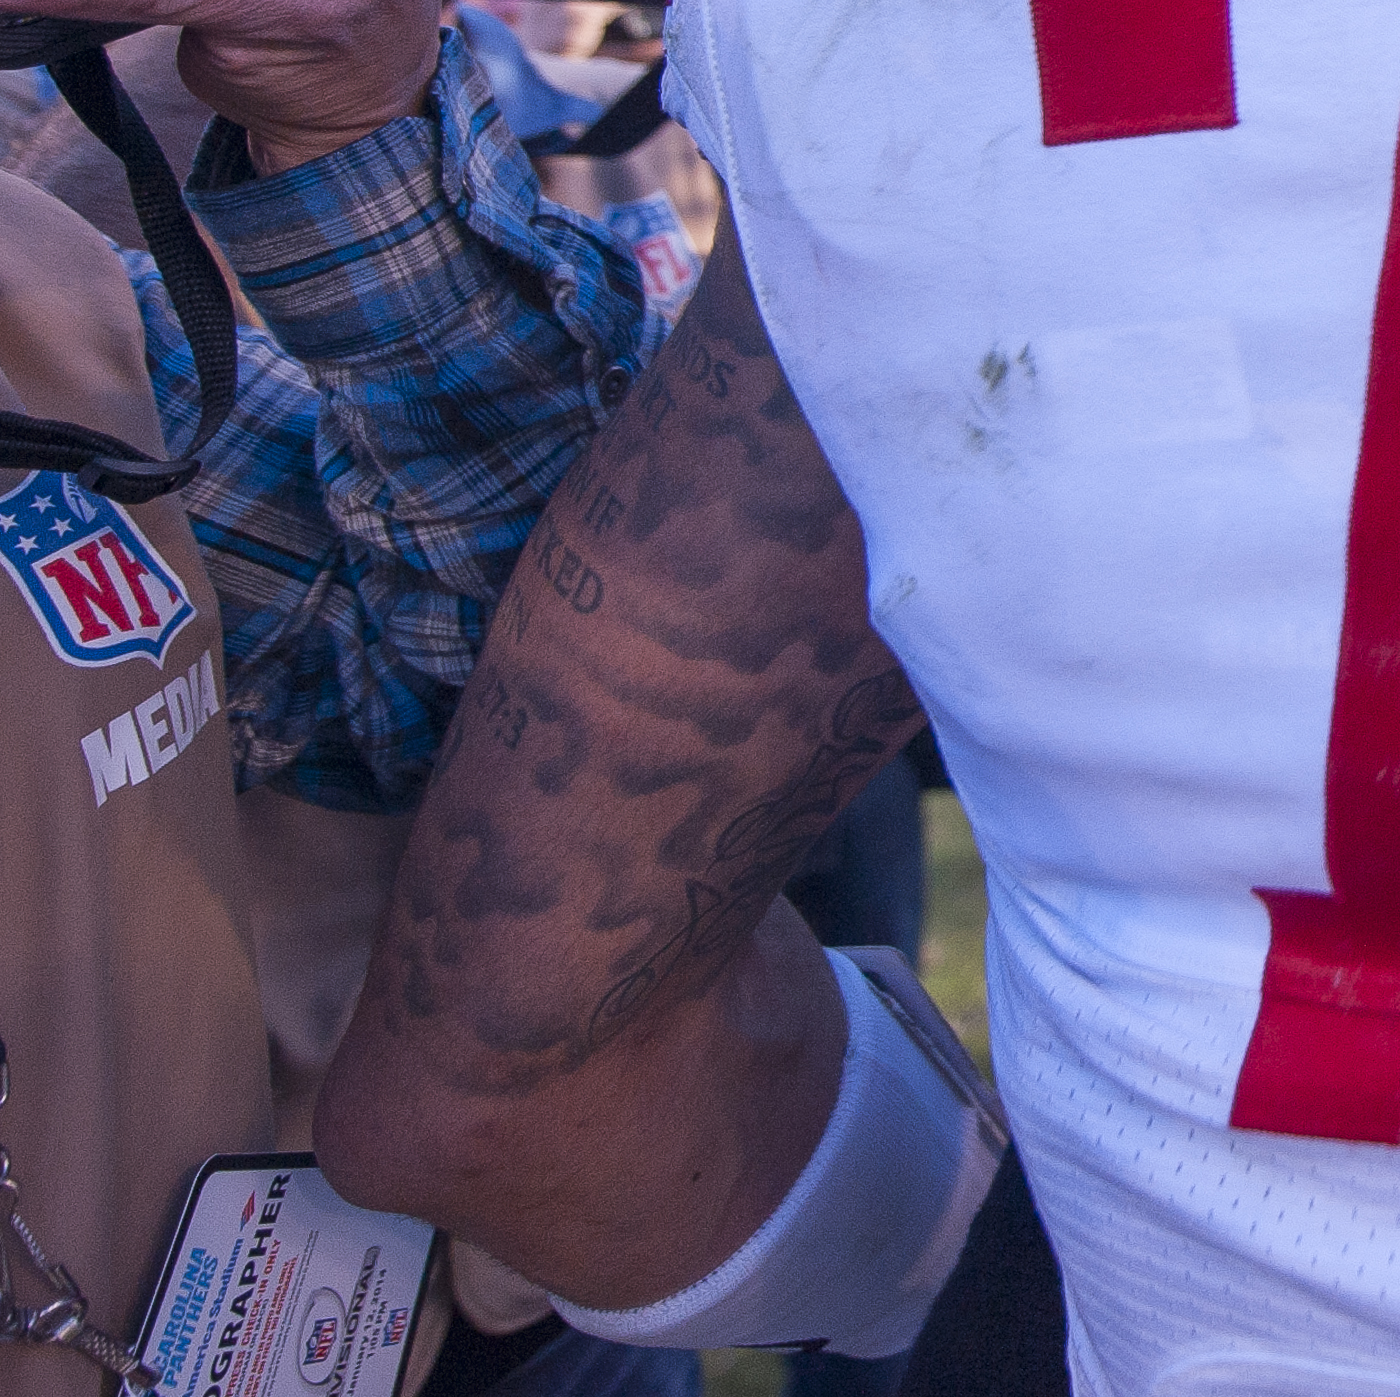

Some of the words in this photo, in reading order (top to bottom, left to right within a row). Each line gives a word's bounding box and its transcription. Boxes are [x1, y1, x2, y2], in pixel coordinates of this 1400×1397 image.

[633, 235, 691, 295] FL
[40, 531, 178, 644] NF
[80, 649, 221, 808] MEDIA
[209, 1238, 244, 1318] Stadium
[264, 1239, 282, 1275] ONLY
[152, 1247, 207, 1373] CAROLINA
[162, 1255, 218, 1388] PANTHERS
[314, 1320, 337, 1360] NFL
